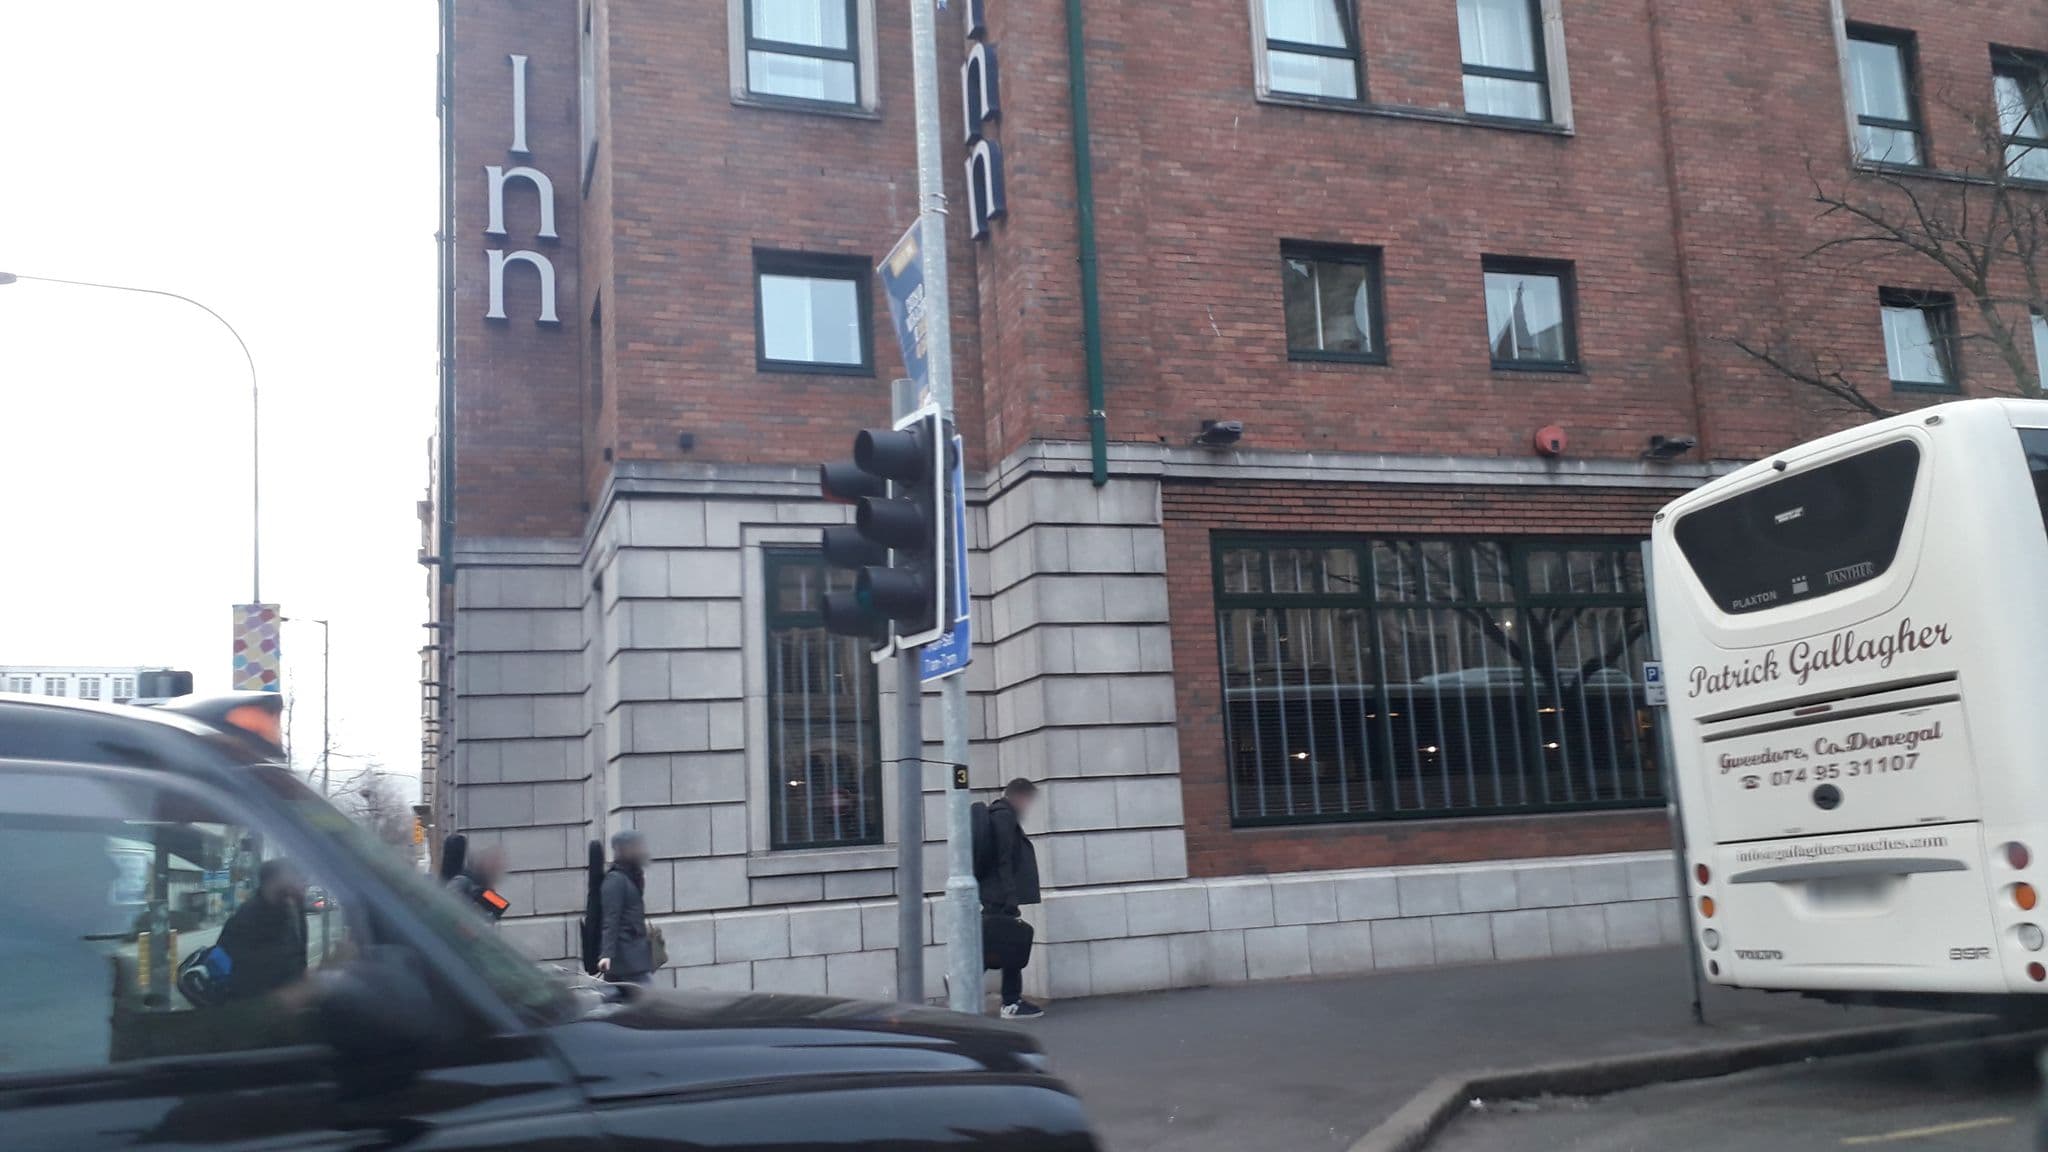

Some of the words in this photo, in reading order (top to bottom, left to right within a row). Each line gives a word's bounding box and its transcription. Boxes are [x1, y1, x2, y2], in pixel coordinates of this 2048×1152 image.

[1825, 561, 1874, 585] PANTHER
[1732, 590, 1777, 610] PLAXTON
[1688, 649, 1780, 698] Patrick
[1789, 617, 1952, 686] Gallagher
[957, 769, 967, 783] 3
[1771, 767, 1808, 787] 074
[1815, 763, 1841, 780] 95
[1849, 753, 1920, 777] 31107
[1735, 949, 1783, 960] VOLVO
